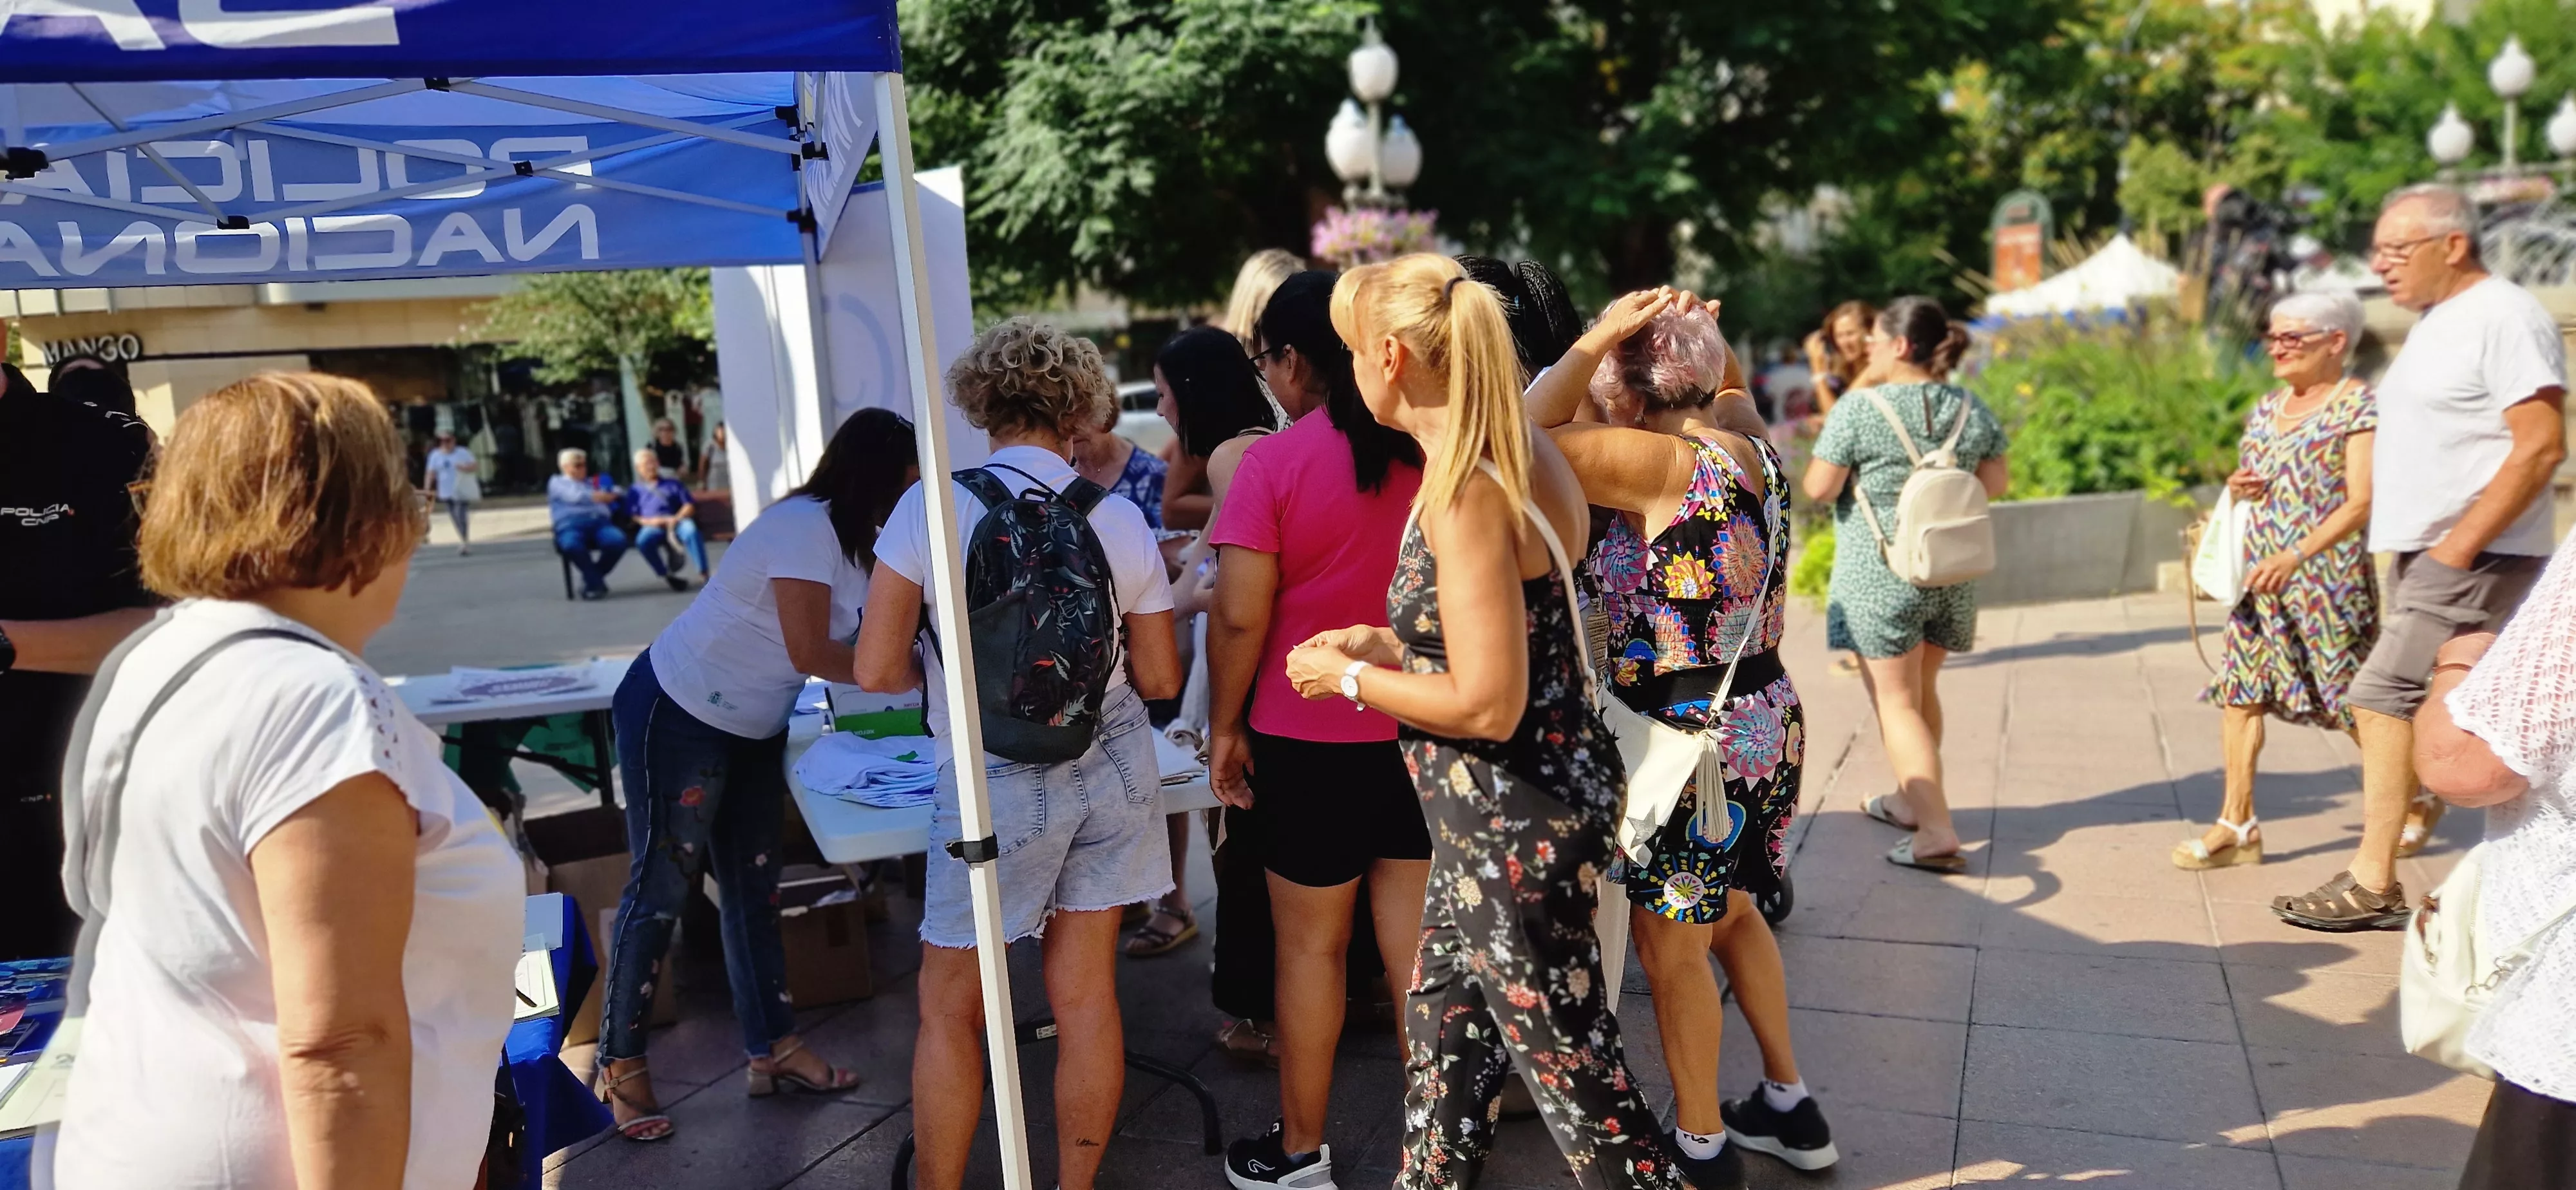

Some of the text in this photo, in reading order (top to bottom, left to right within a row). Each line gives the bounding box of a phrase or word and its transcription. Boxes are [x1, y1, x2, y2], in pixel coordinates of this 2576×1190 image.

[41, 333, 140, 365] MANGO
[0, 503, 70, 516] POLICIA
[21, 514, 59, 525] CNP
